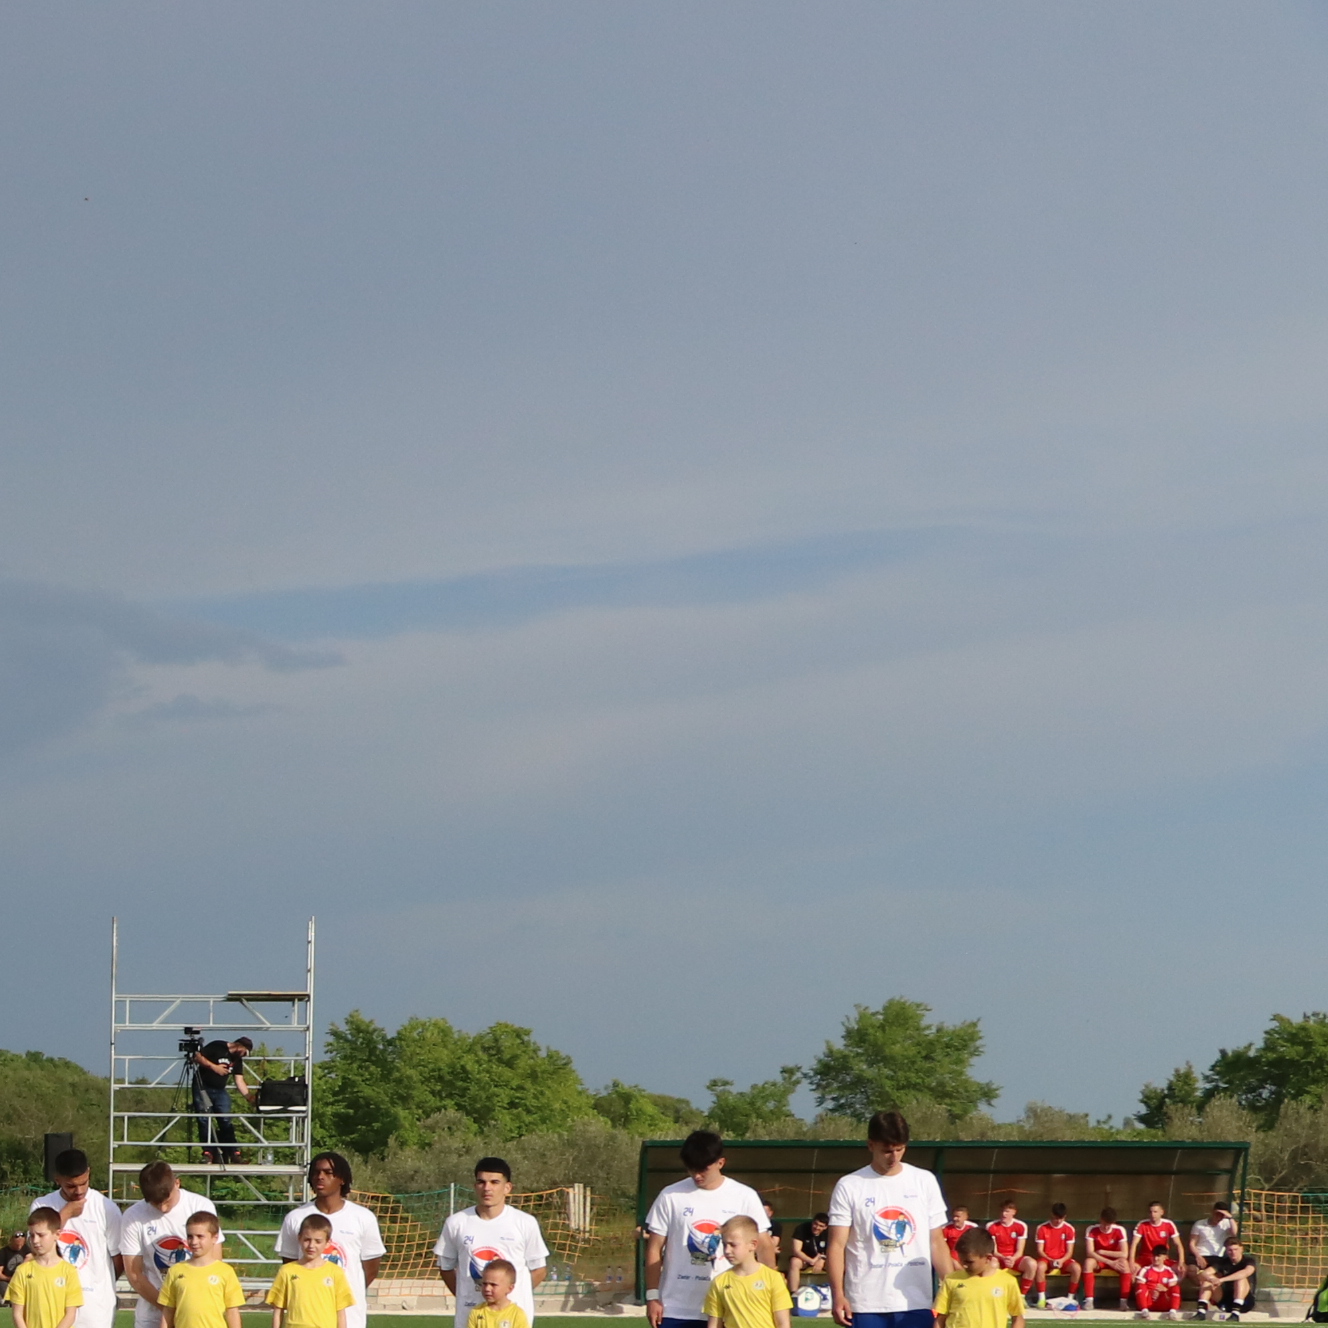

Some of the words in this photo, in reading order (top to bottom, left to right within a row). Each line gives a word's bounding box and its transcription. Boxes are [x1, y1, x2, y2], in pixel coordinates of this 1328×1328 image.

[865, 1197, 875, 1207] 24
[683, 1207, 694, 1216] 24
[146, 1226, 157, 1236] 24
[464, 1235, 474, 1245] 24
